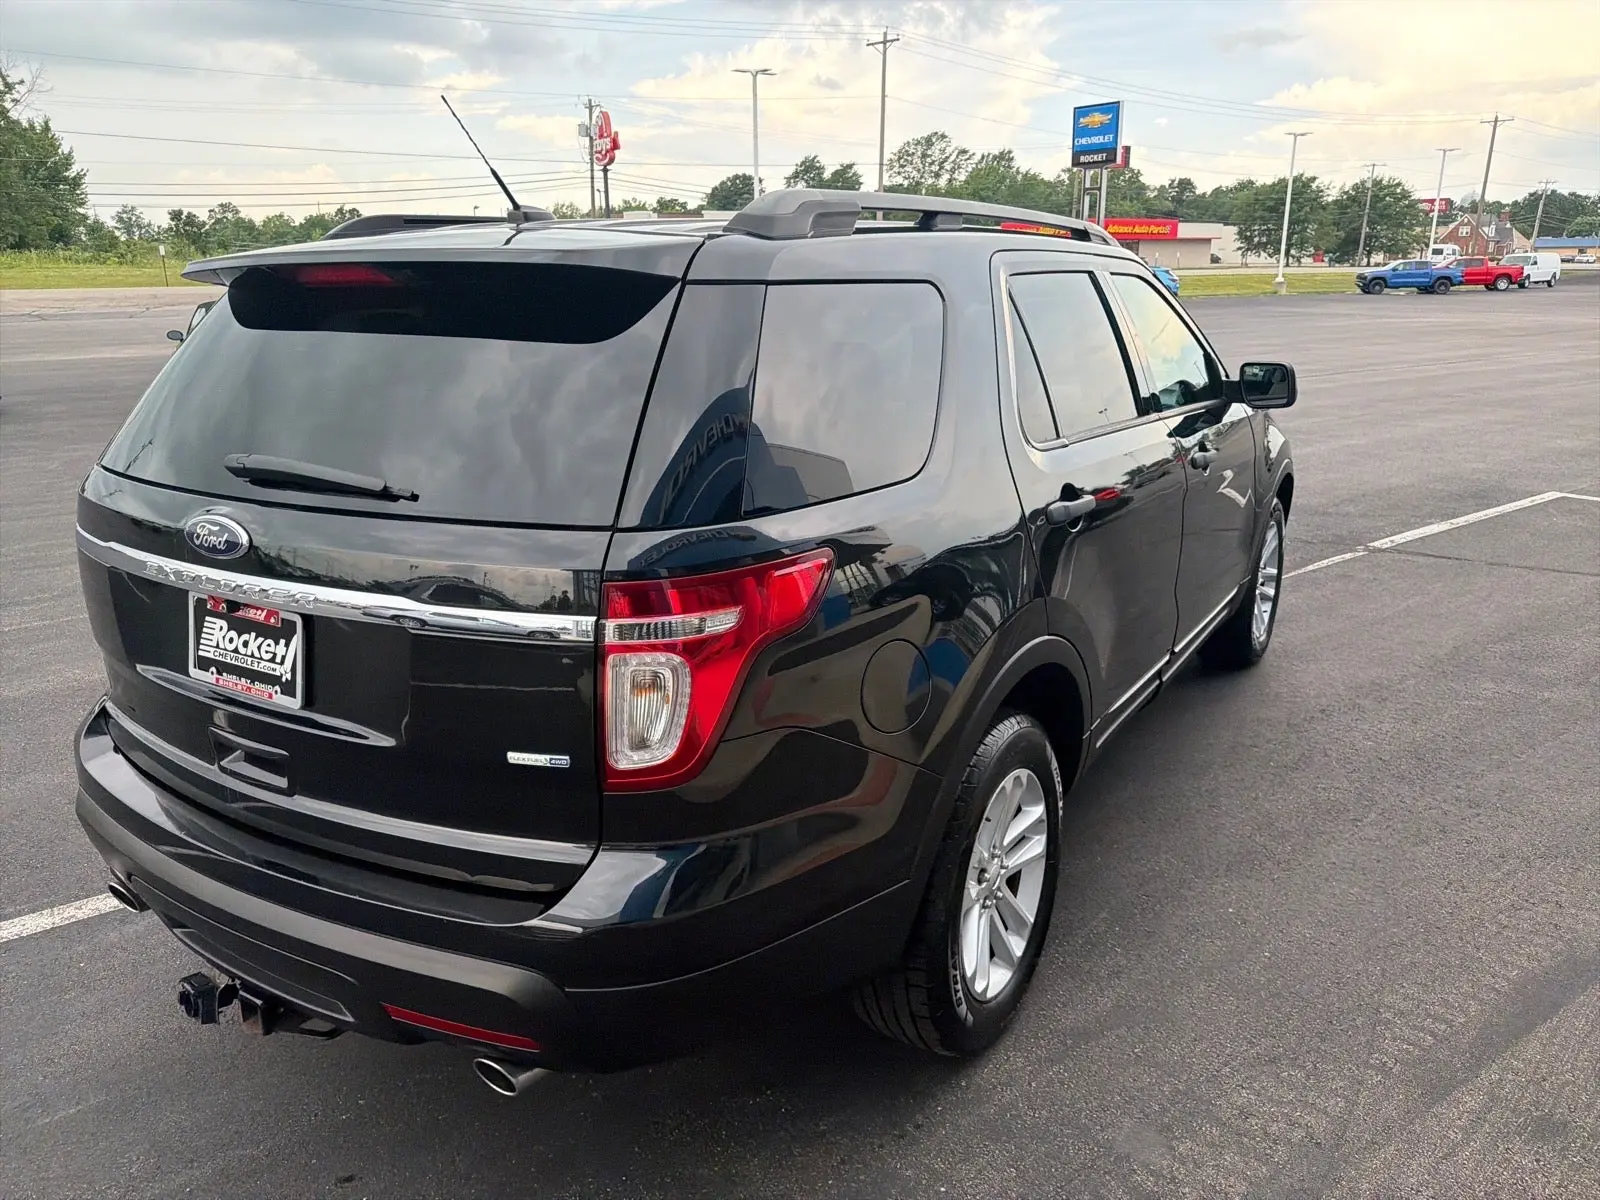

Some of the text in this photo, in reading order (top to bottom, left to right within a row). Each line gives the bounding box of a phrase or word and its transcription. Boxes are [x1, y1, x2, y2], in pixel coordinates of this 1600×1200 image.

[1075, 134, 1114, 145] CHEVROLET
[1080, 153, 1107, 163] ROCKET
[1106, 224, 1167, 234] Advance Auto Parts
[193, 522, 228, 550] Ford
[143, 561, 319, 609] EXPLORER
[200, 616, 287, 663] Rocket
[254, 681, 274, 692] OHIO
[250, 687, 270, 698] OHIO
